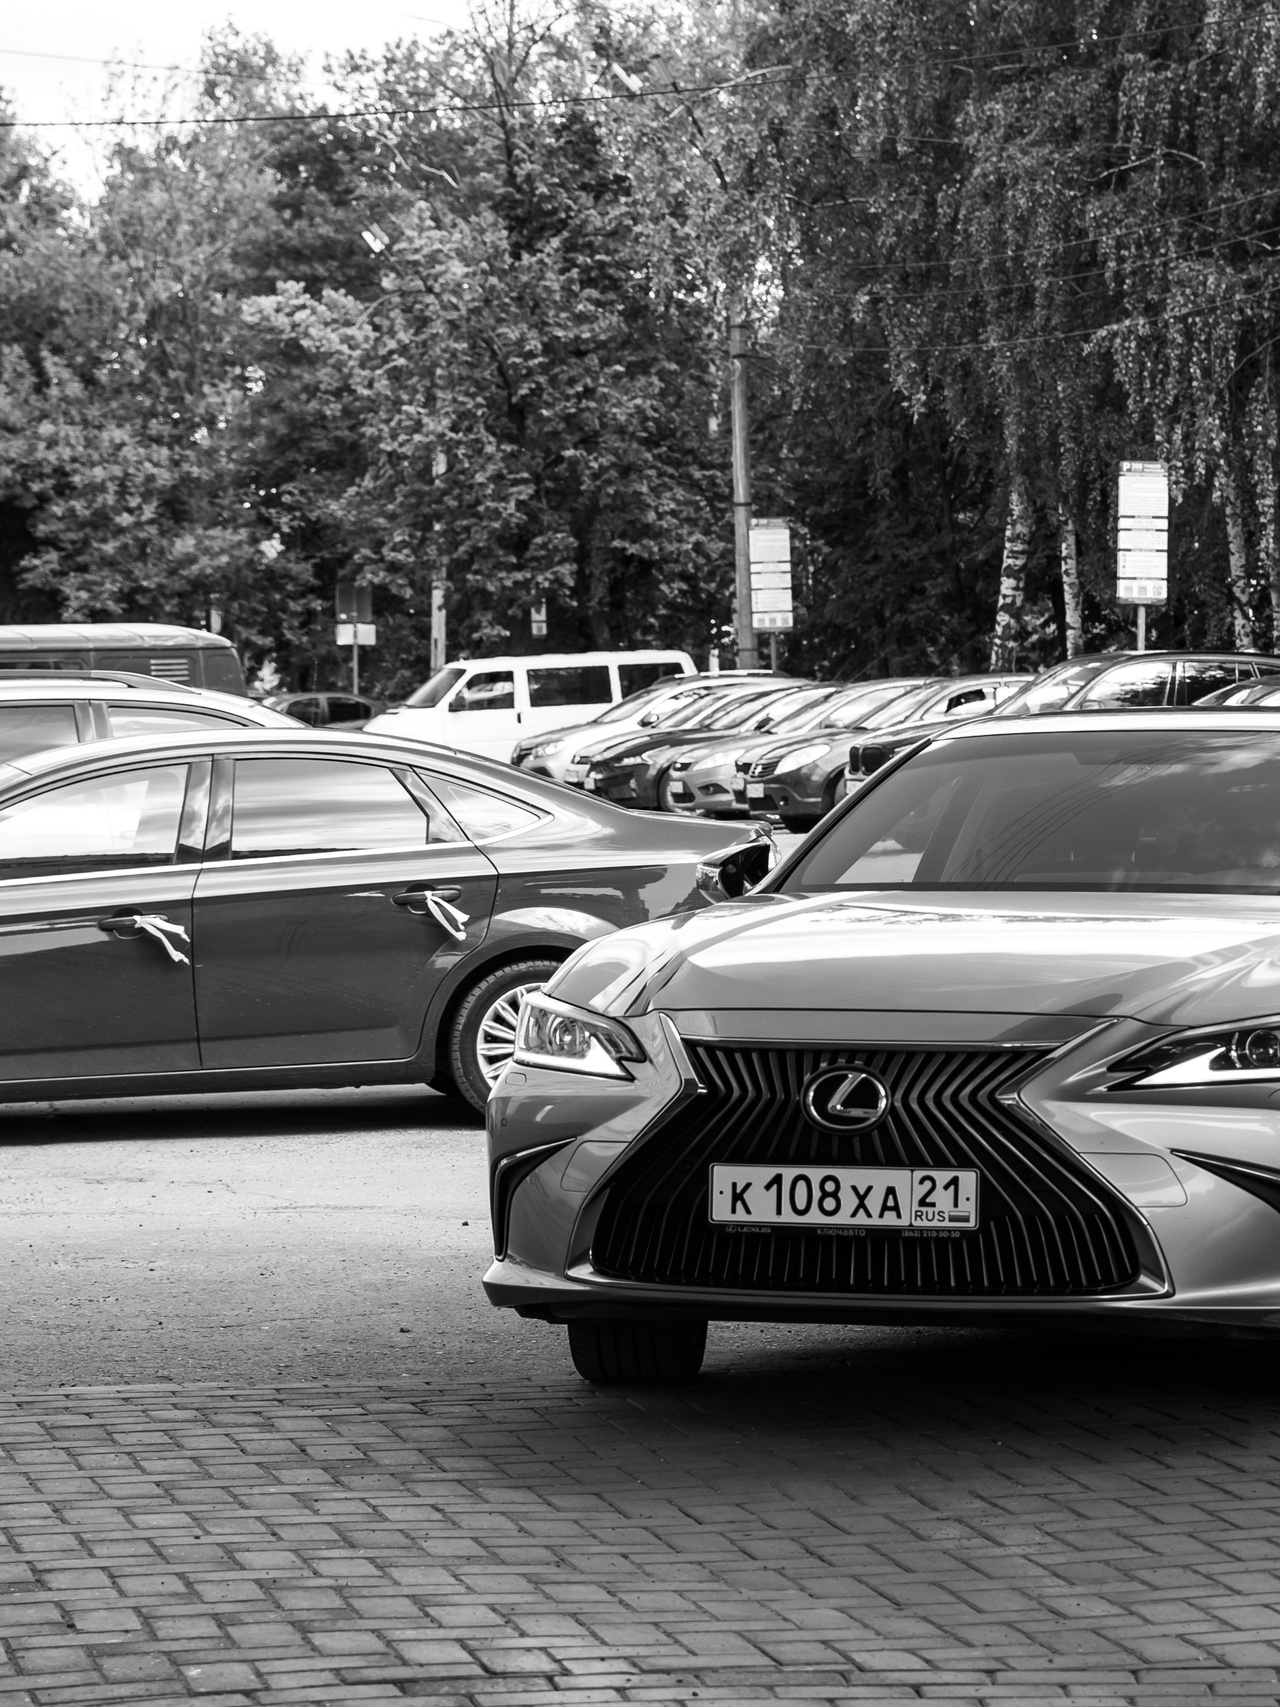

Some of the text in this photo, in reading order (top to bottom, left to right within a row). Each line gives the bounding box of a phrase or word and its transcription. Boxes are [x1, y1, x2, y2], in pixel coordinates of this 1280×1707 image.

[917, 1174, 960, 1209] 21
[914, 1210, 946, 1223] RUS
[737, 1225, 772, 1233] LEXUS
